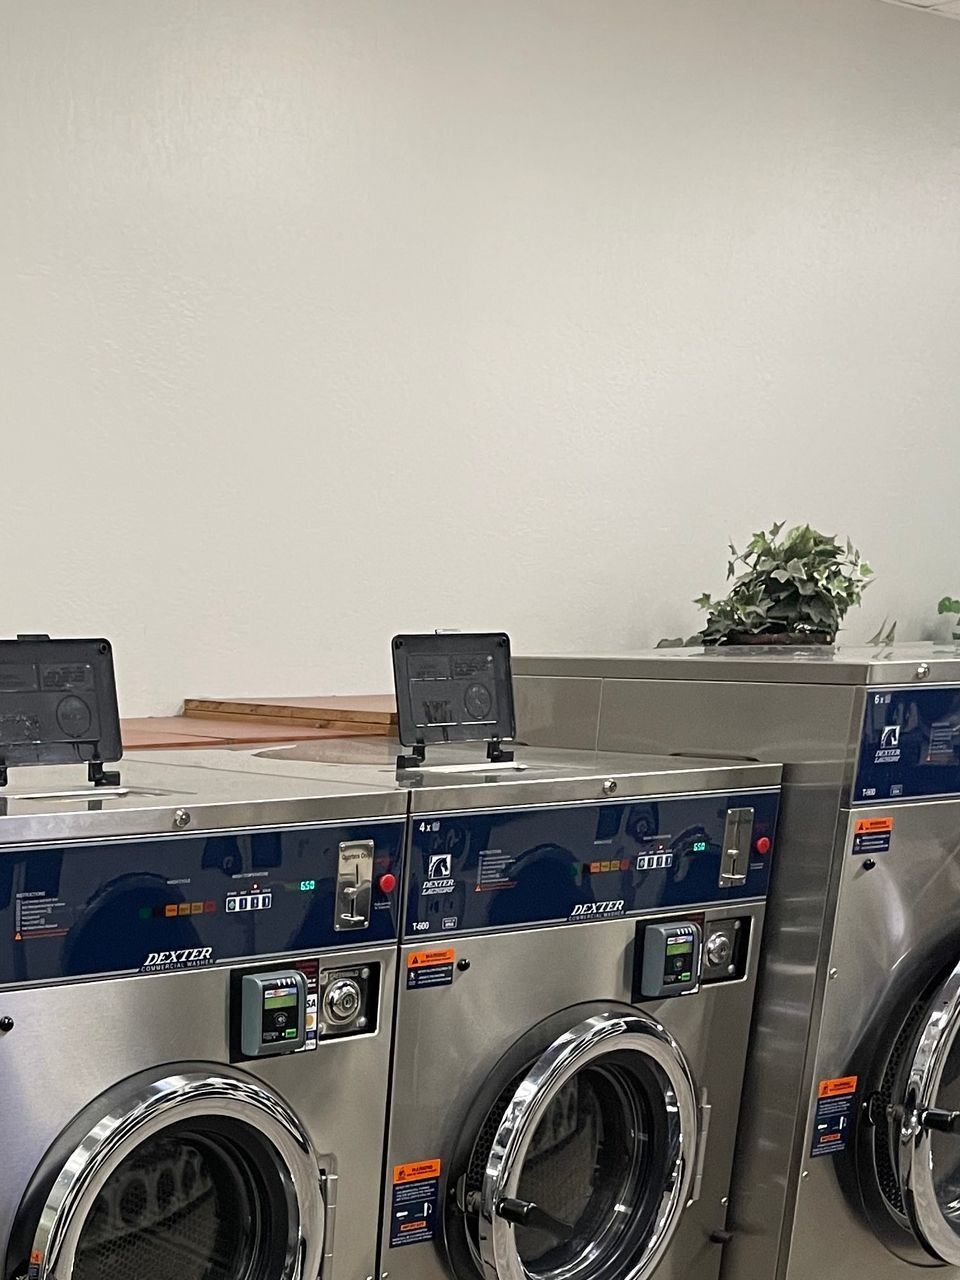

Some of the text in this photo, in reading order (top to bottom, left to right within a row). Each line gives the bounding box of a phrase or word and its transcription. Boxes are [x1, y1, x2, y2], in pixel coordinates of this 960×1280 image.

[874, 694, 880, 704] 6
[875, 749, 901, 757] DEXTER
[419, 822, 425, 832] 4
[423, 879, 454, 889] DEXTER
[571, 900, 624, 915] DEXTER
[412, 922, 429, 930] T-600
[144, 947, 212, 966] DEXTER
[141, 963, 184, 972] COMMERCIAL
